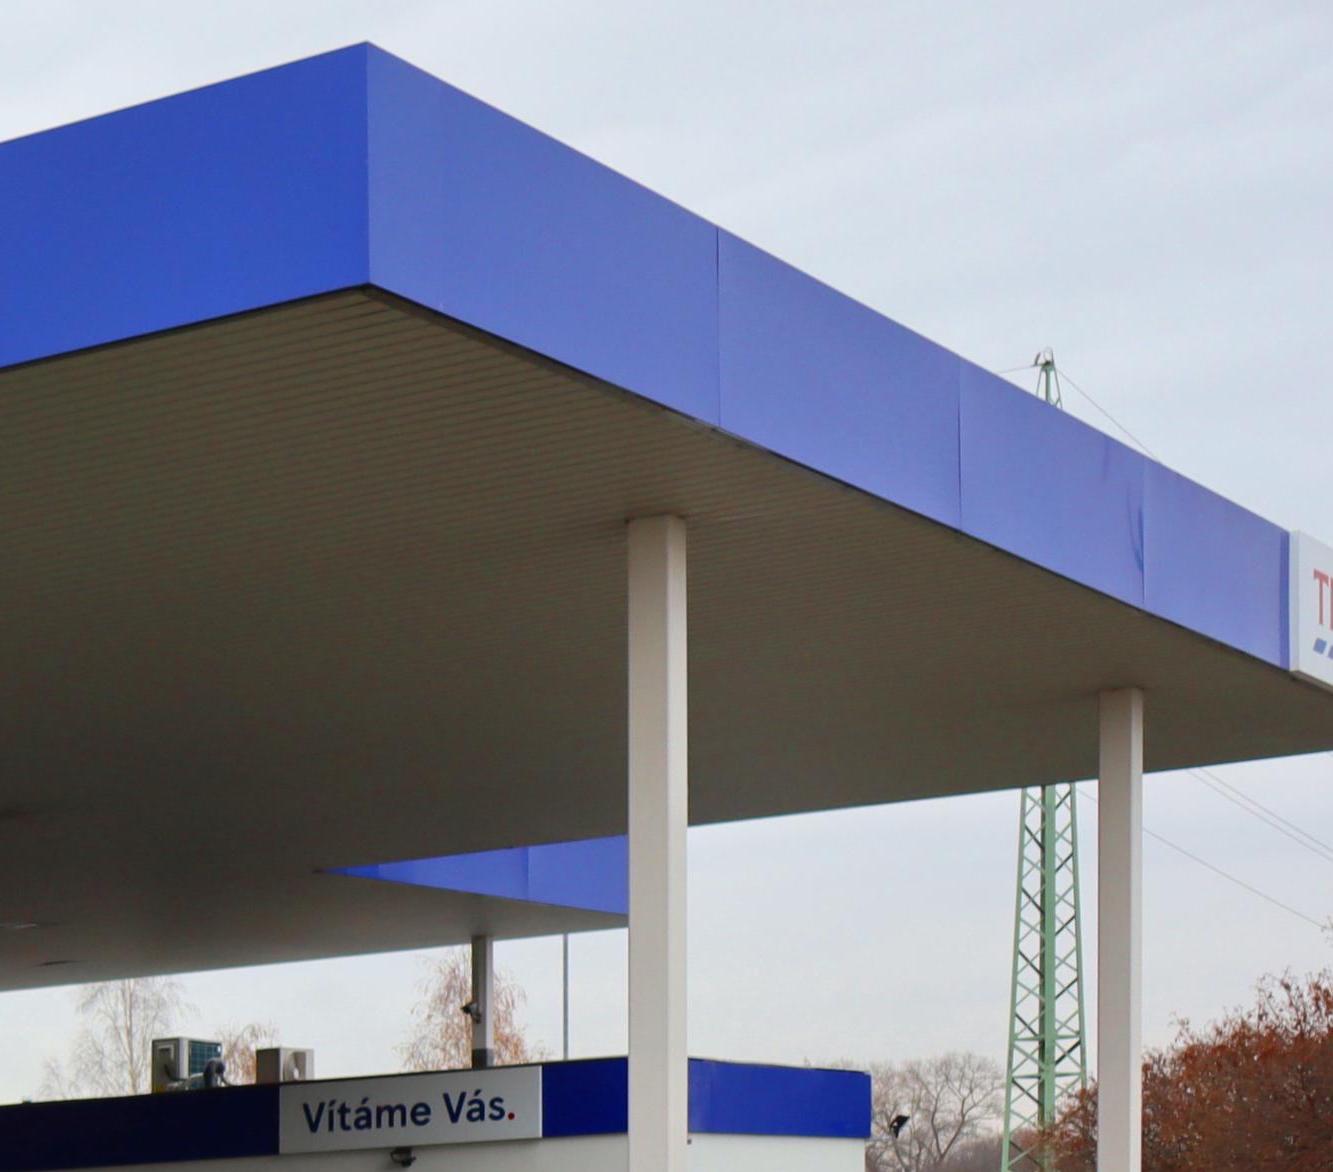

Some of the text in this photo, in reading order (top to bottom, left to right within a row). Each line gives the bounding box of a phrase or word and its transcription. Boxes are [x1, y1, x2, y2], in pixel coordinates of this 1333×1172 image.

[1313, 567, 1333, 631] T
[302, 1088, 516, 1134] Vítáme Vás.
